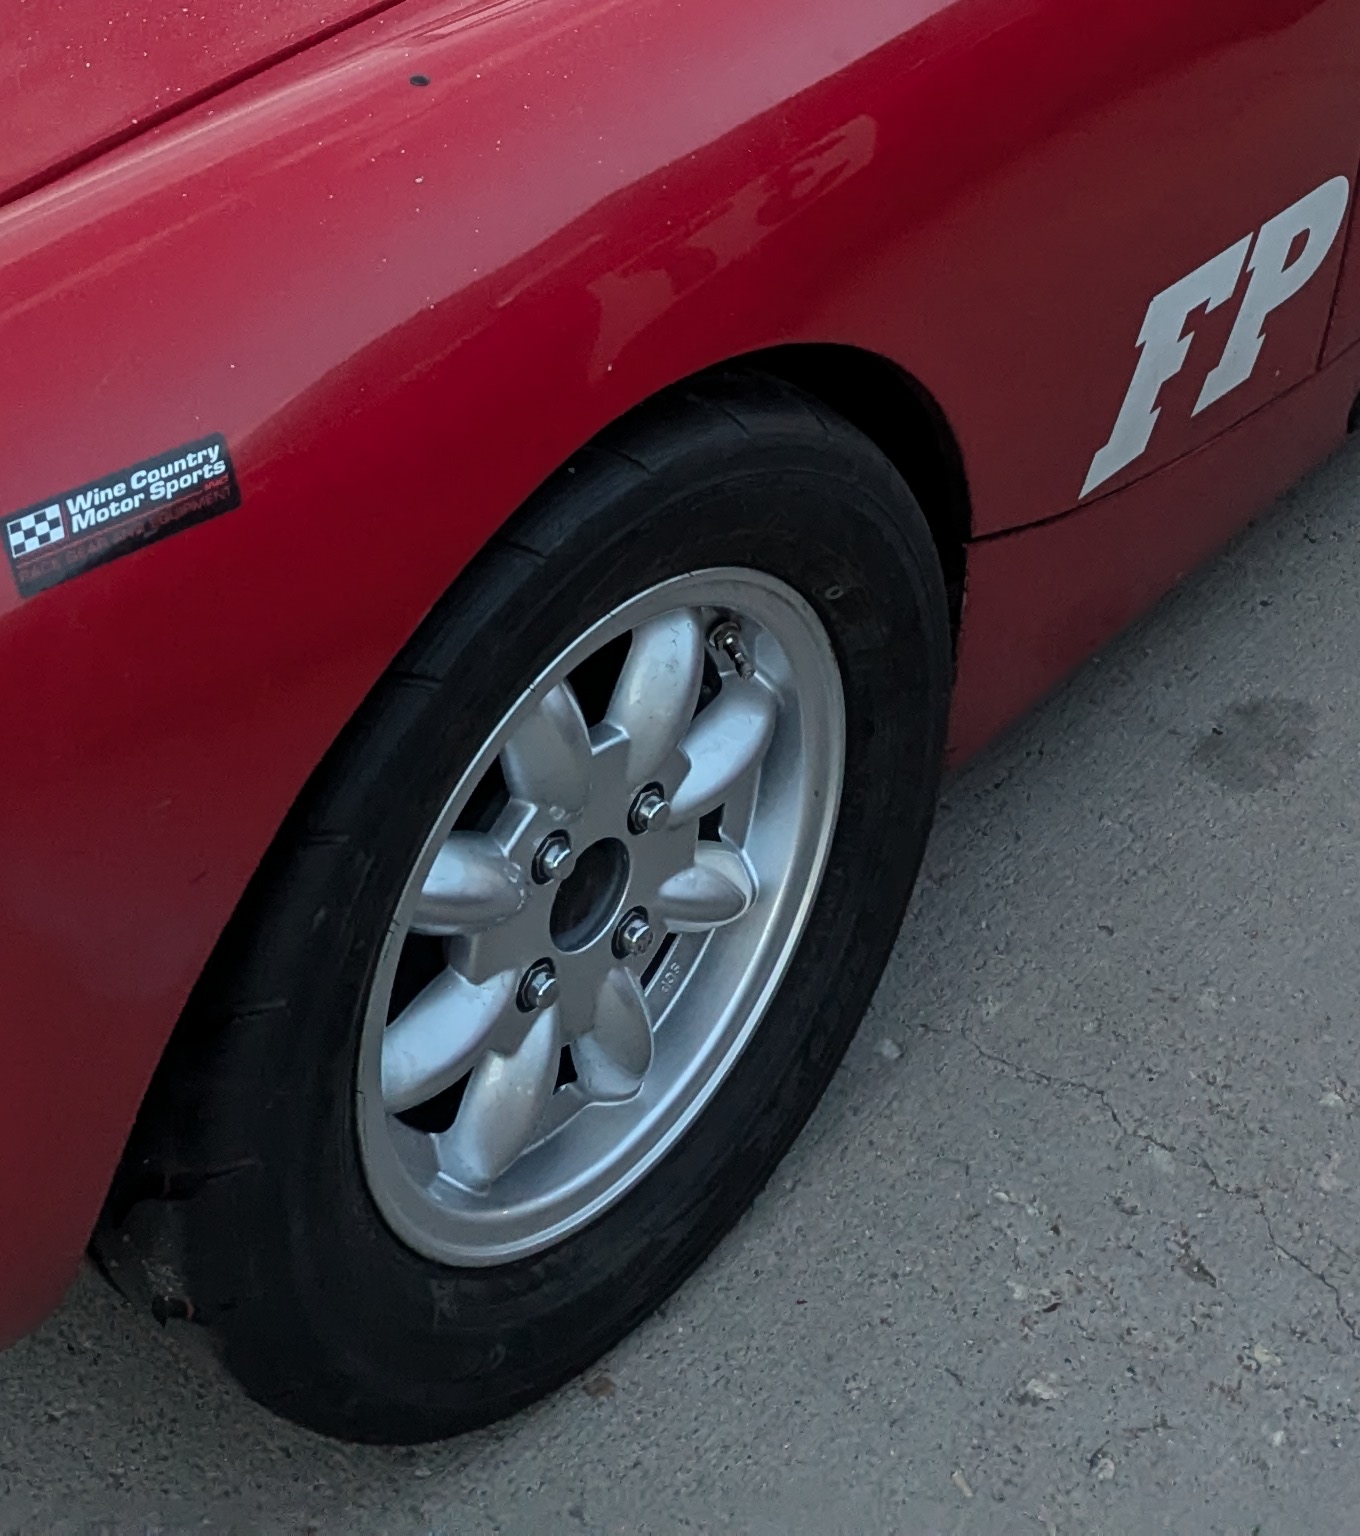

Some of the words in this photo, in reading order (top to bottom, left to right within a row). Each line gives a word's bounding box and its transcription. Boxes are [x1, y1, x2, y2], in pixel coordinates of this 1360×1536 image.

[1078, 175, 1349, 499] FP
[65, 480, 126, 514] Wine
[130, 444, 220, 490] Country
[70, 493, 145, 533] Motor
[149, 460, 226, 501] Sports
